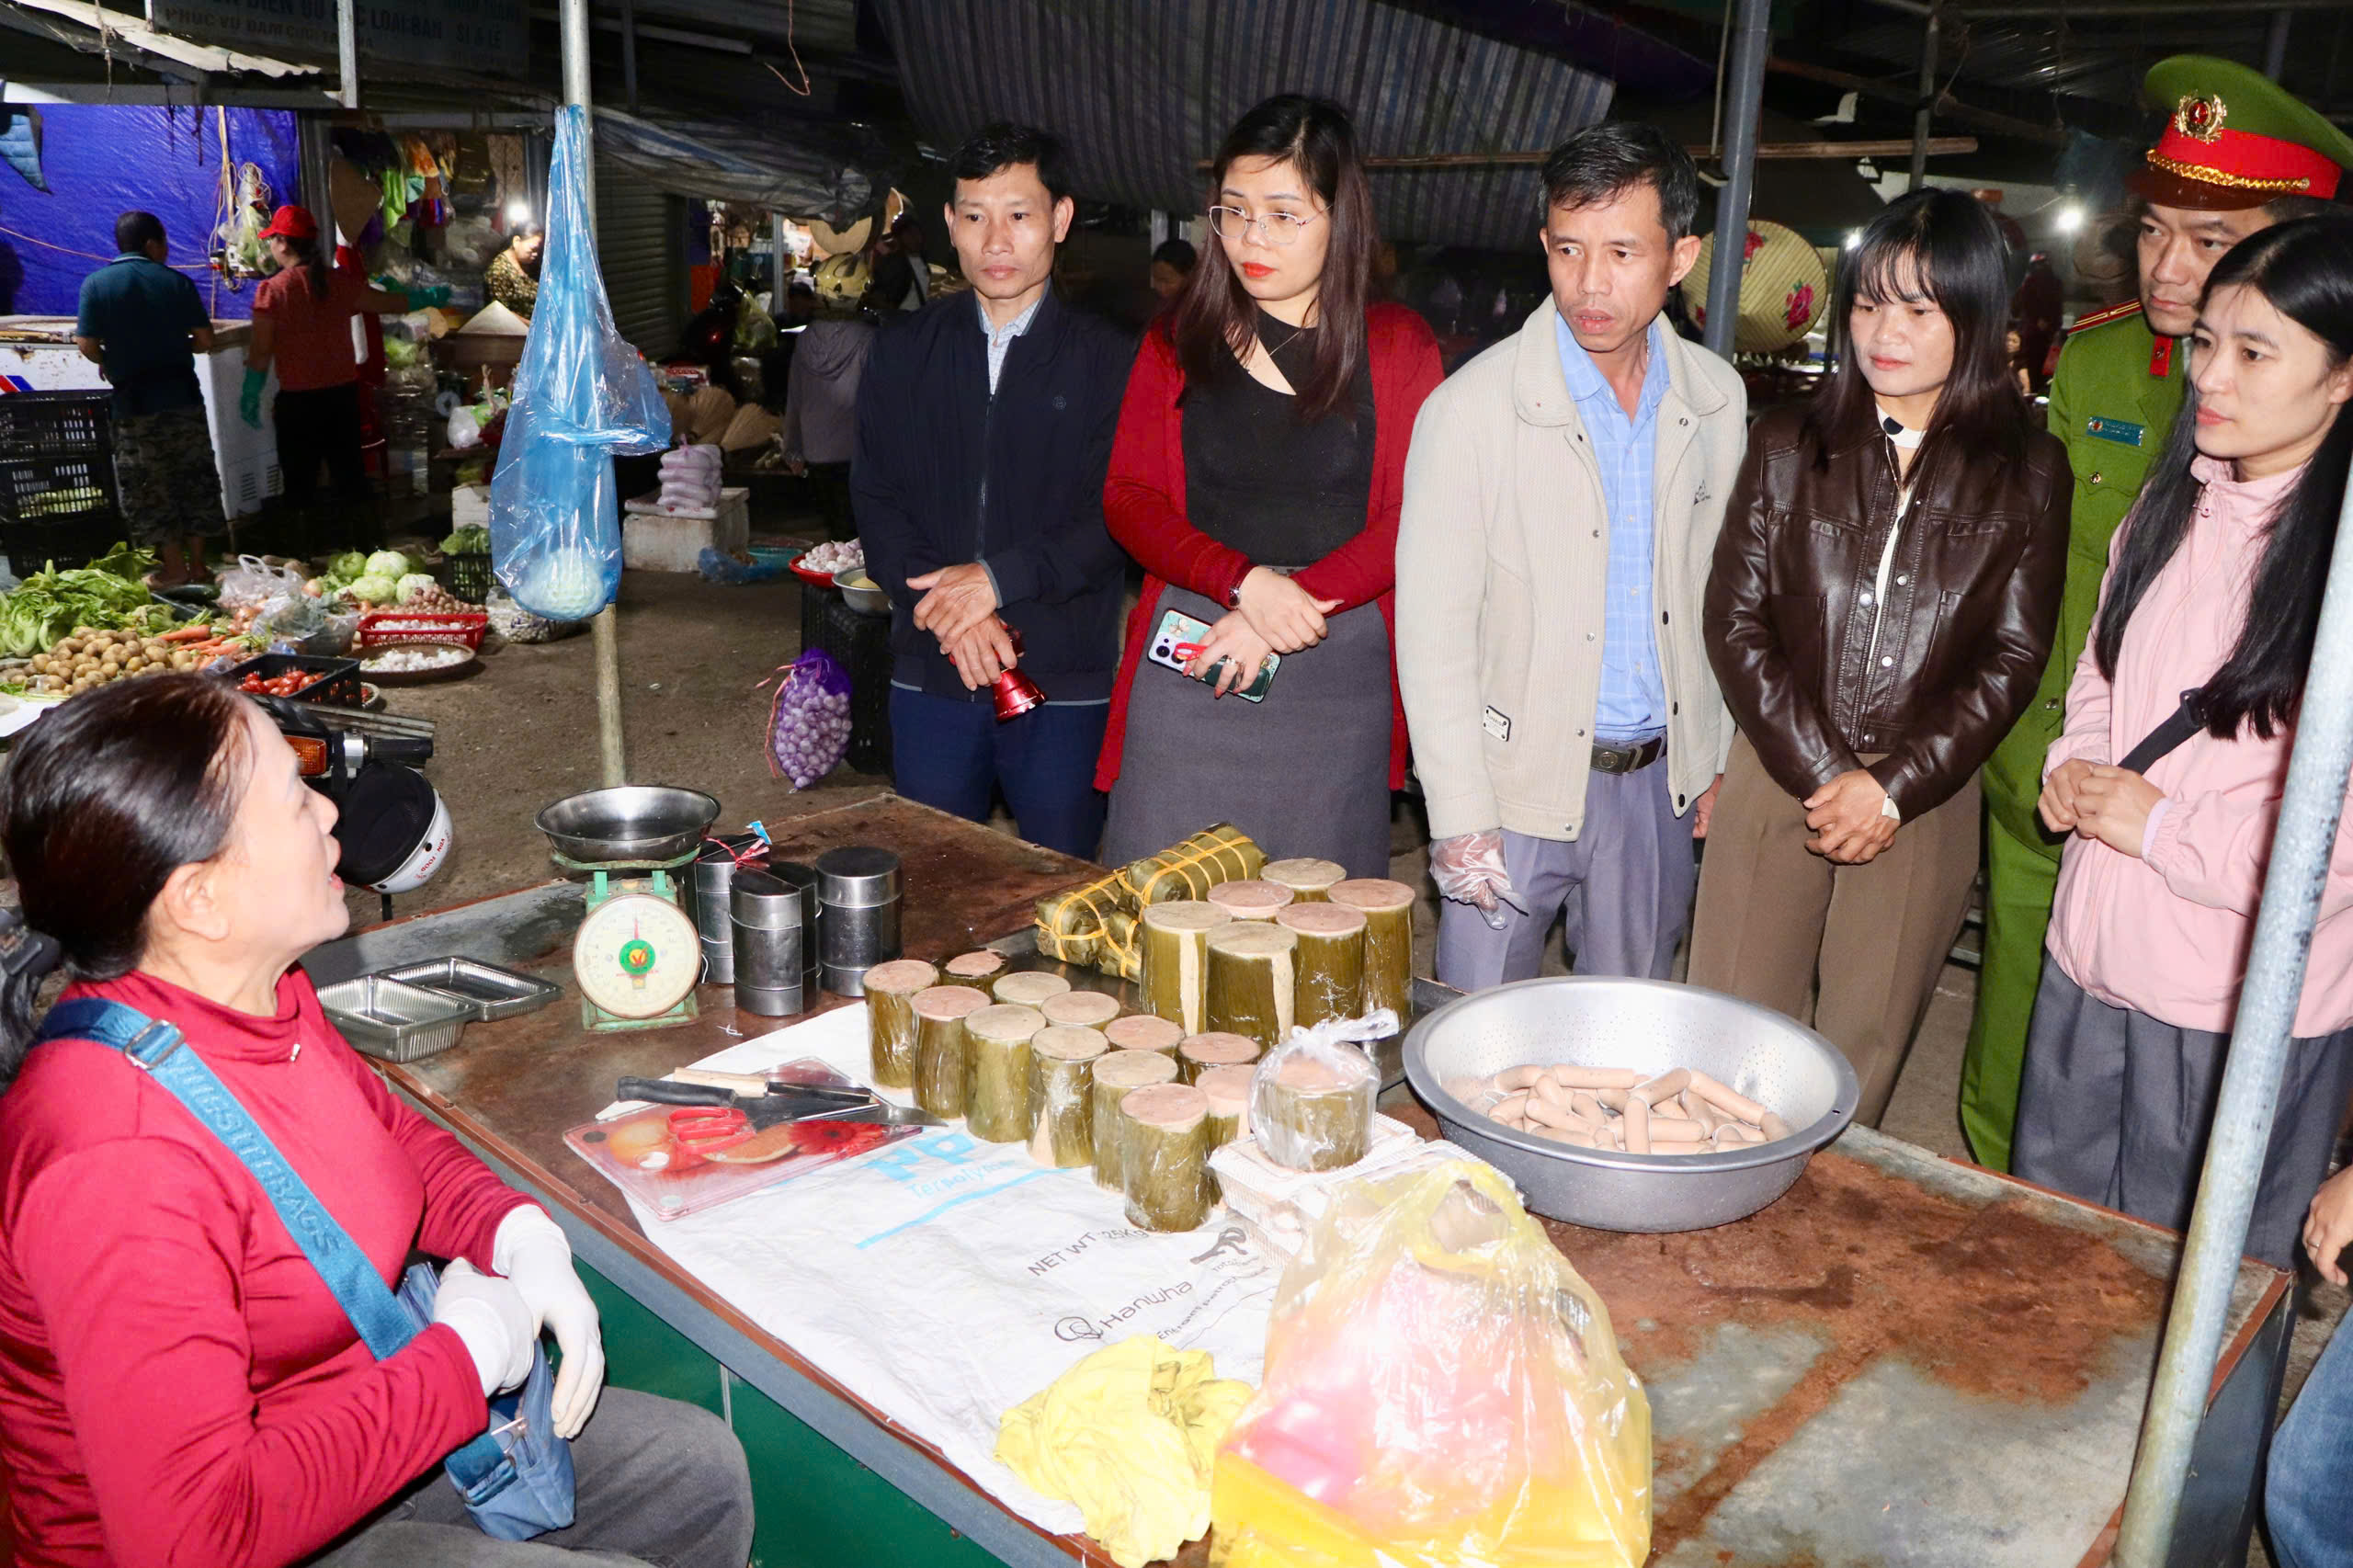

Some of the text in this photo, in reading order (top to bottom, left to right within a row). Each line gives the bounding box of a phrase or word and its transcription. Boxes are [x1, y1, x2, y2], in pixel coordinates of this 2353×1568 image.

[860, 1133, 977, 1183] PP
[1027, 1250, 1067, 1277] NET
[1066, 1231, 1098, 1256] WT
[1099, 1279, 1193, 1329] Hanwha
